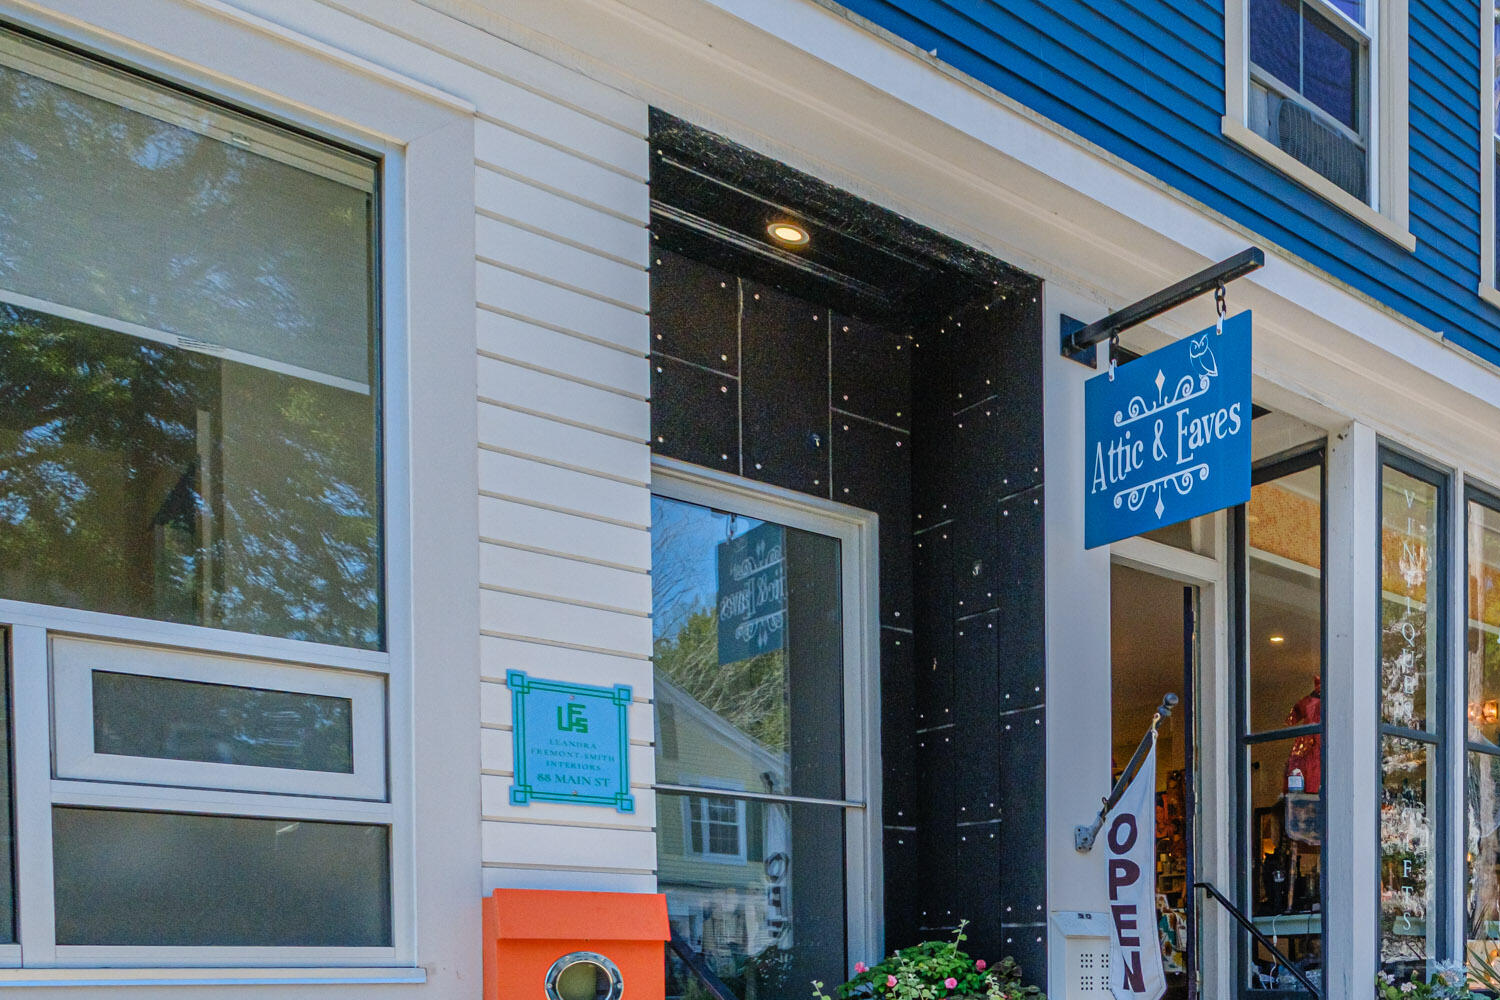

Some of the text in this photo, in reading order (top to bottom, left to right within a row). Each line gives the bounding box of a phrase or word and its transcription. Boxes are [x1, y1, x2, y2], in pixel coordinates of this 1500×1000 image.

[1091, 402, 1242, 494] Attic & Eaves
[536, 773, 611, 788] 88 MAIN ST
[545, 760, 601, 771] INTERIORS
[1107, 813, 1147, 993] OPEN
